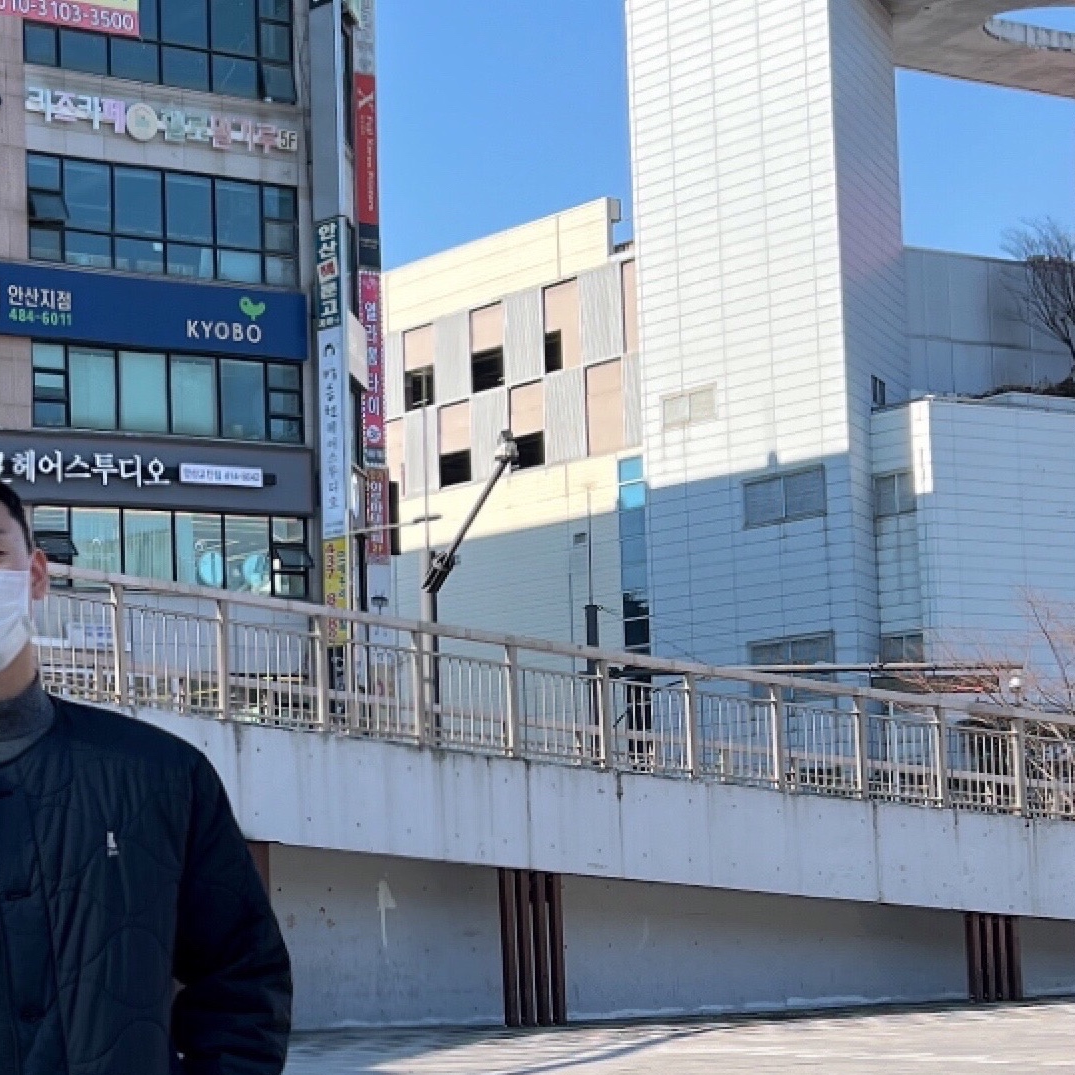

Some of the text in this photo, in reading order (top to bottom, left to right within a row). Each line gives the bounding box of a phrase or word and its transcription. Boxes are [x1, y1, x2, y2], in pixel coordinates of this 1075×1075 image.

[7, 283, 74, 313] 안산지점
[8, 307, 74, 328] 484-6011
[185, 317, 263, 345] KYOBO
[12, 447, 172, 488] 헤어스투디오
